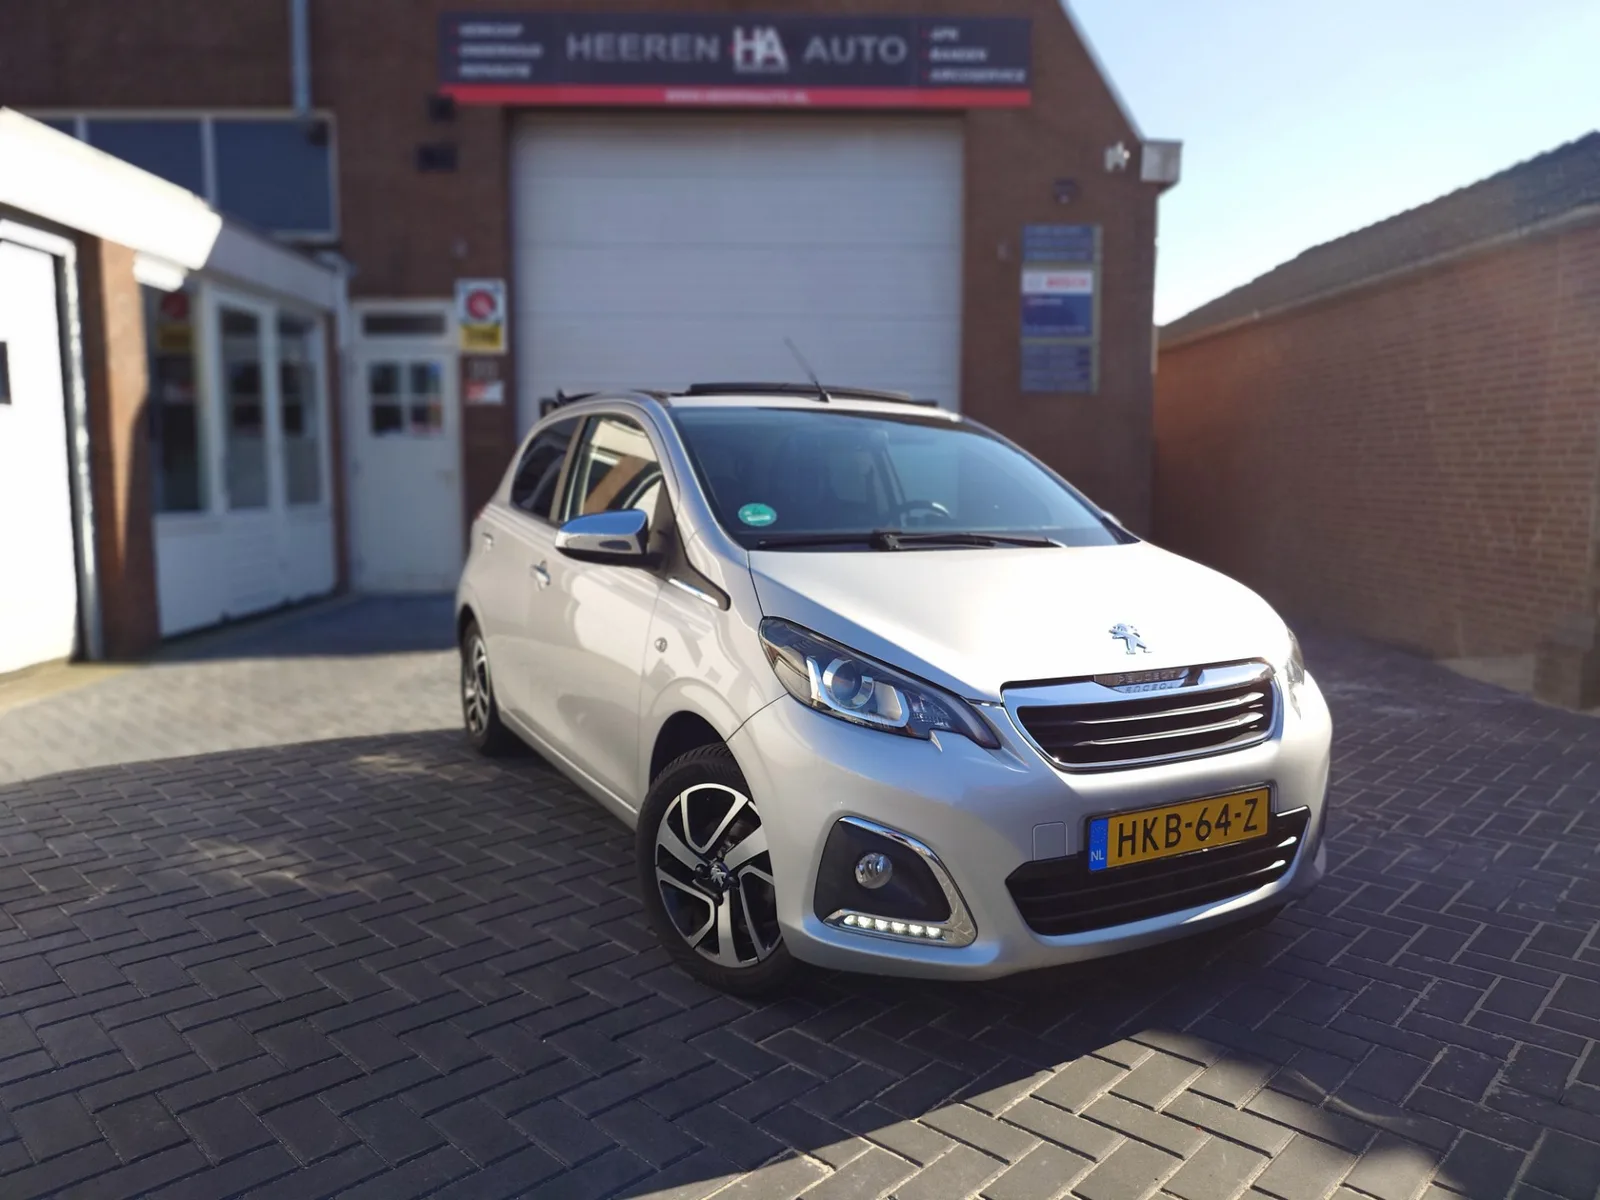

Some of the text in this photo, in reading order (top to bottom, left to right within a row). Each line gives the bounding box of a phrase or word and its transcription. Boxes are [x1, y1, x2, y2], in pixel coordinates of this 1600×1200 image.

[566, 33, 721, 62] HEEREN
[805, 36, 907, 63] AUTO
[1117, 798, 1258, 858] HKB-64-Z
[1090, 850, 1105, 863] NL
